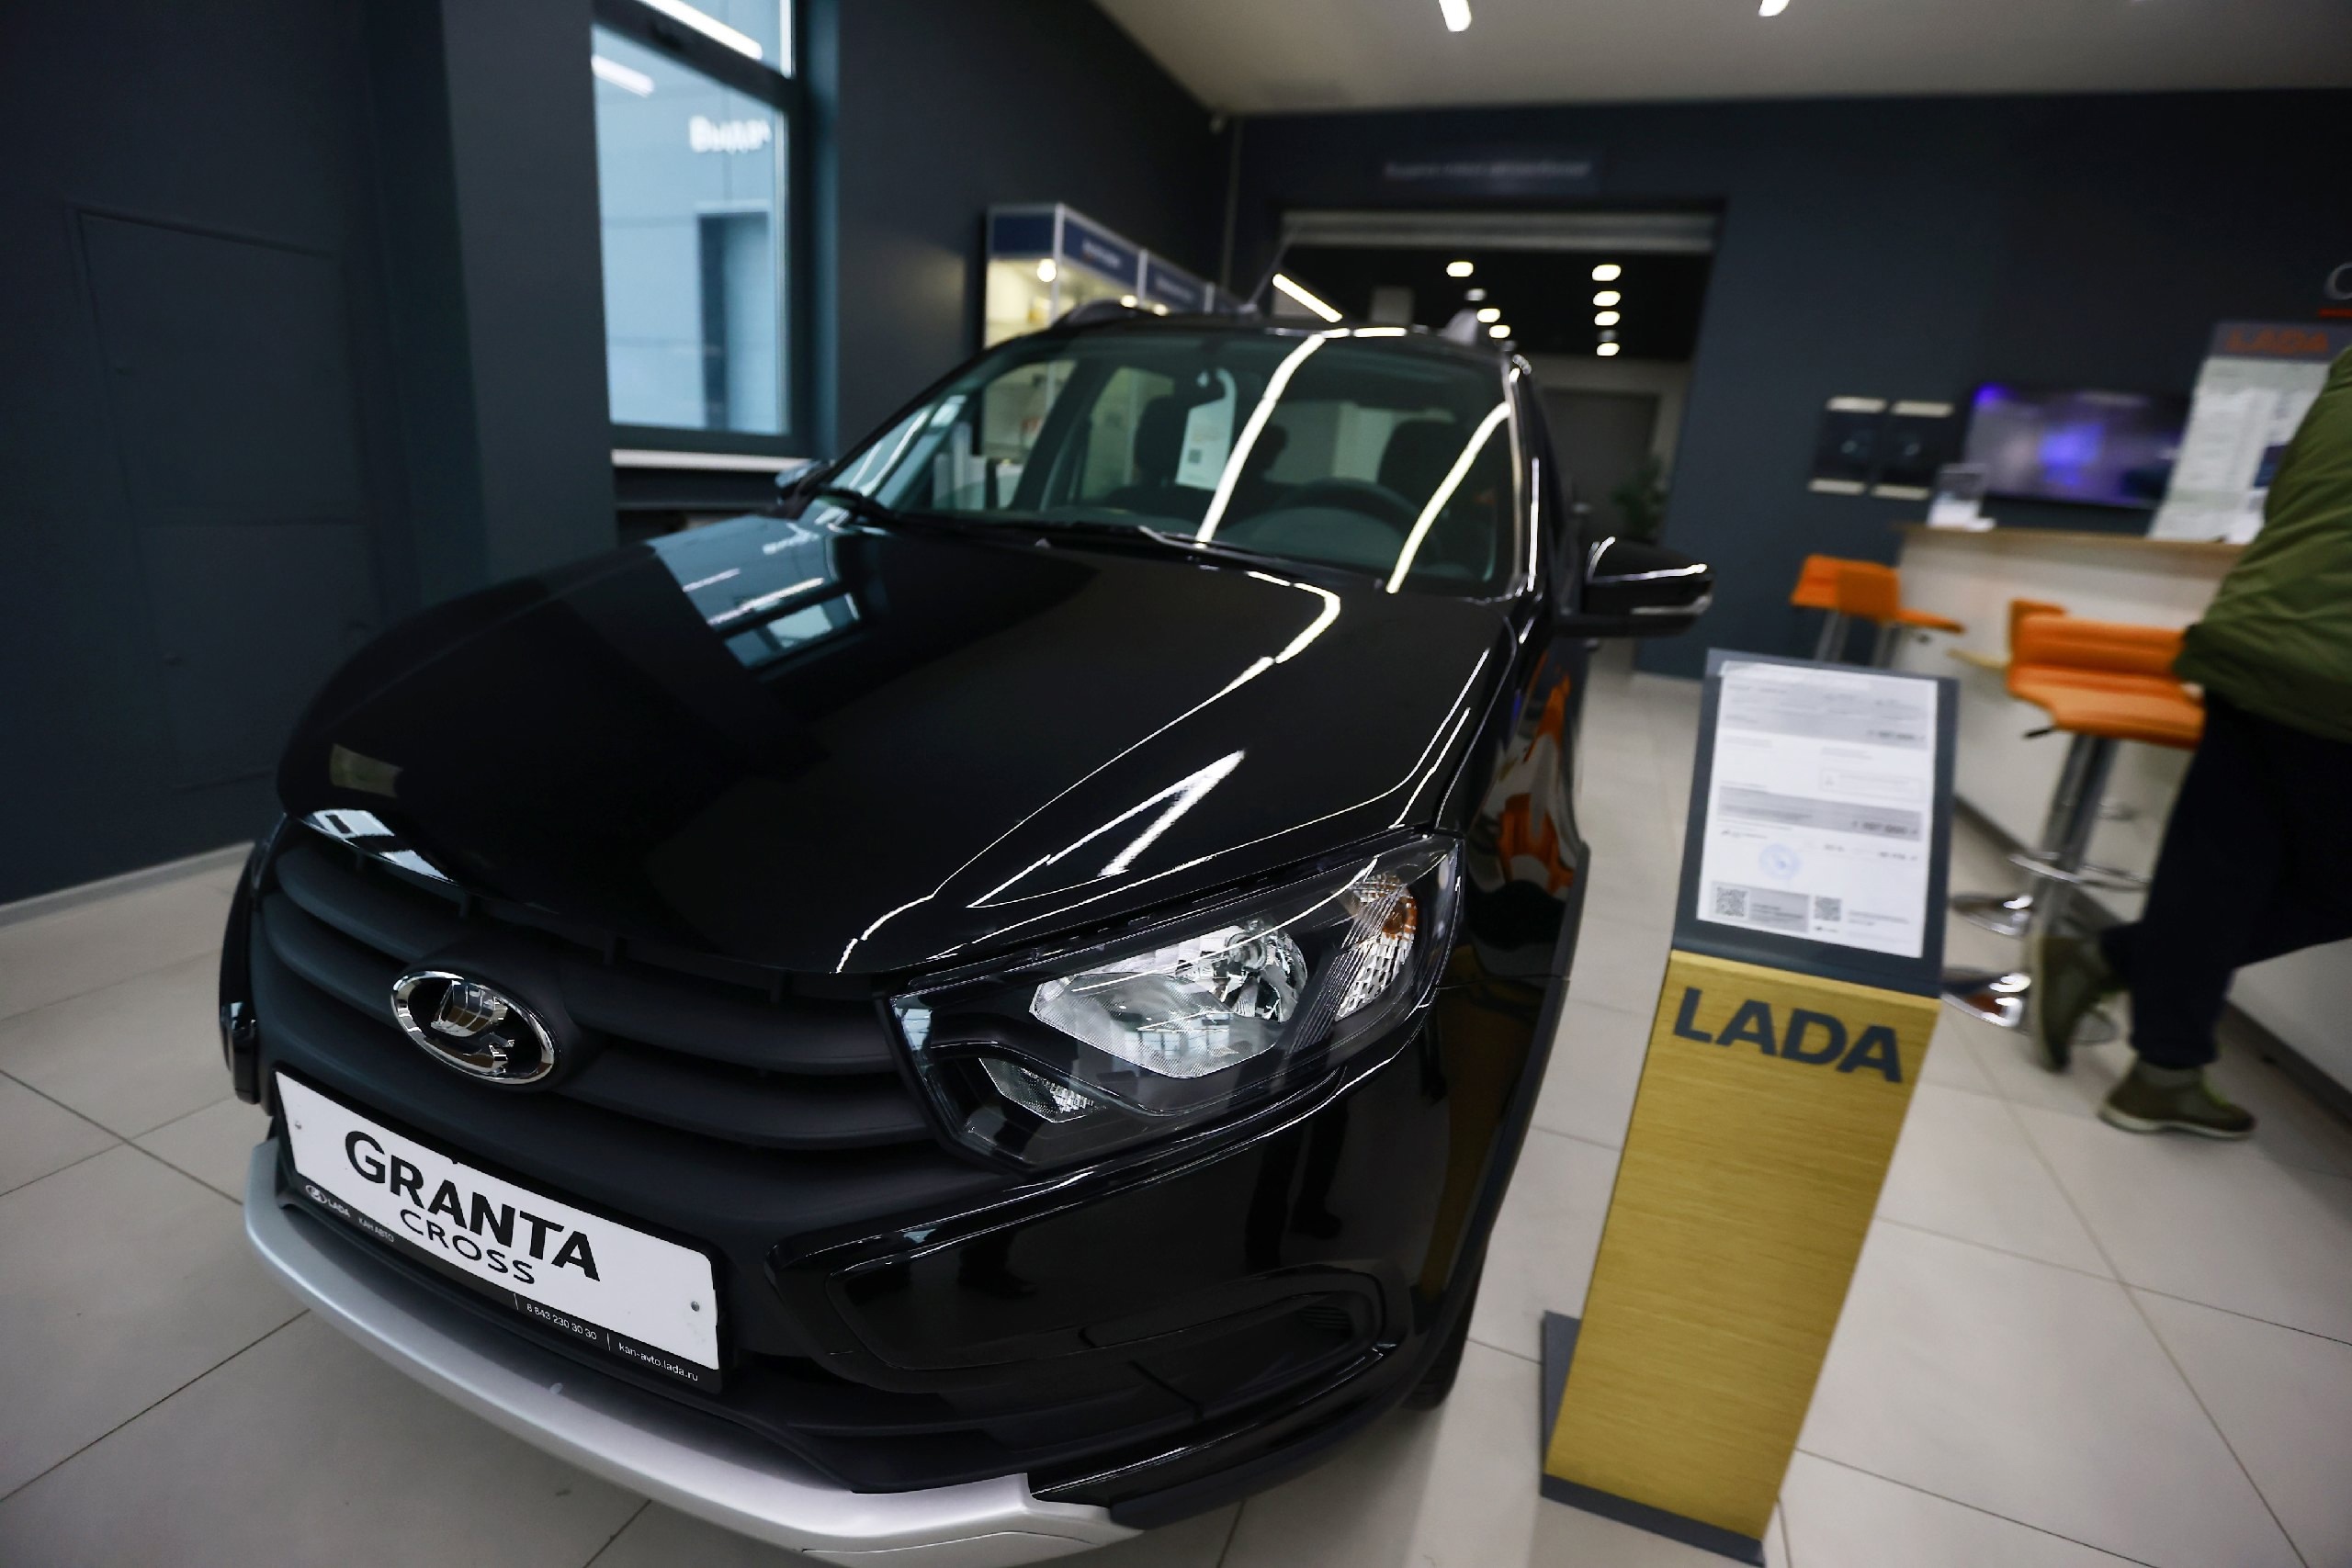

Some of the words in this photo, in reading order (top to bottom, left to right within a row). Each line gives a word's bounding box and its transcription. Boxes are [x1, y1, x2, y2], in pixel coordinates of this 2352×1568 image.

[1672, 987, 1904, 1084] LADA
[345, 1130, 601, 1282] GRANTA
[400, 1208, 536, 1285] CROSS
[526, 1303, 533, 1313] 8
[534, 1306, 551, 1321] 843
[552, 1314, 570, 1329] 230
[571, 1323, 583, 1335] 30
[584, 1327, 597, 1340] 30
[618, 1341, 699, 1382] kan-avto.lada.ru
